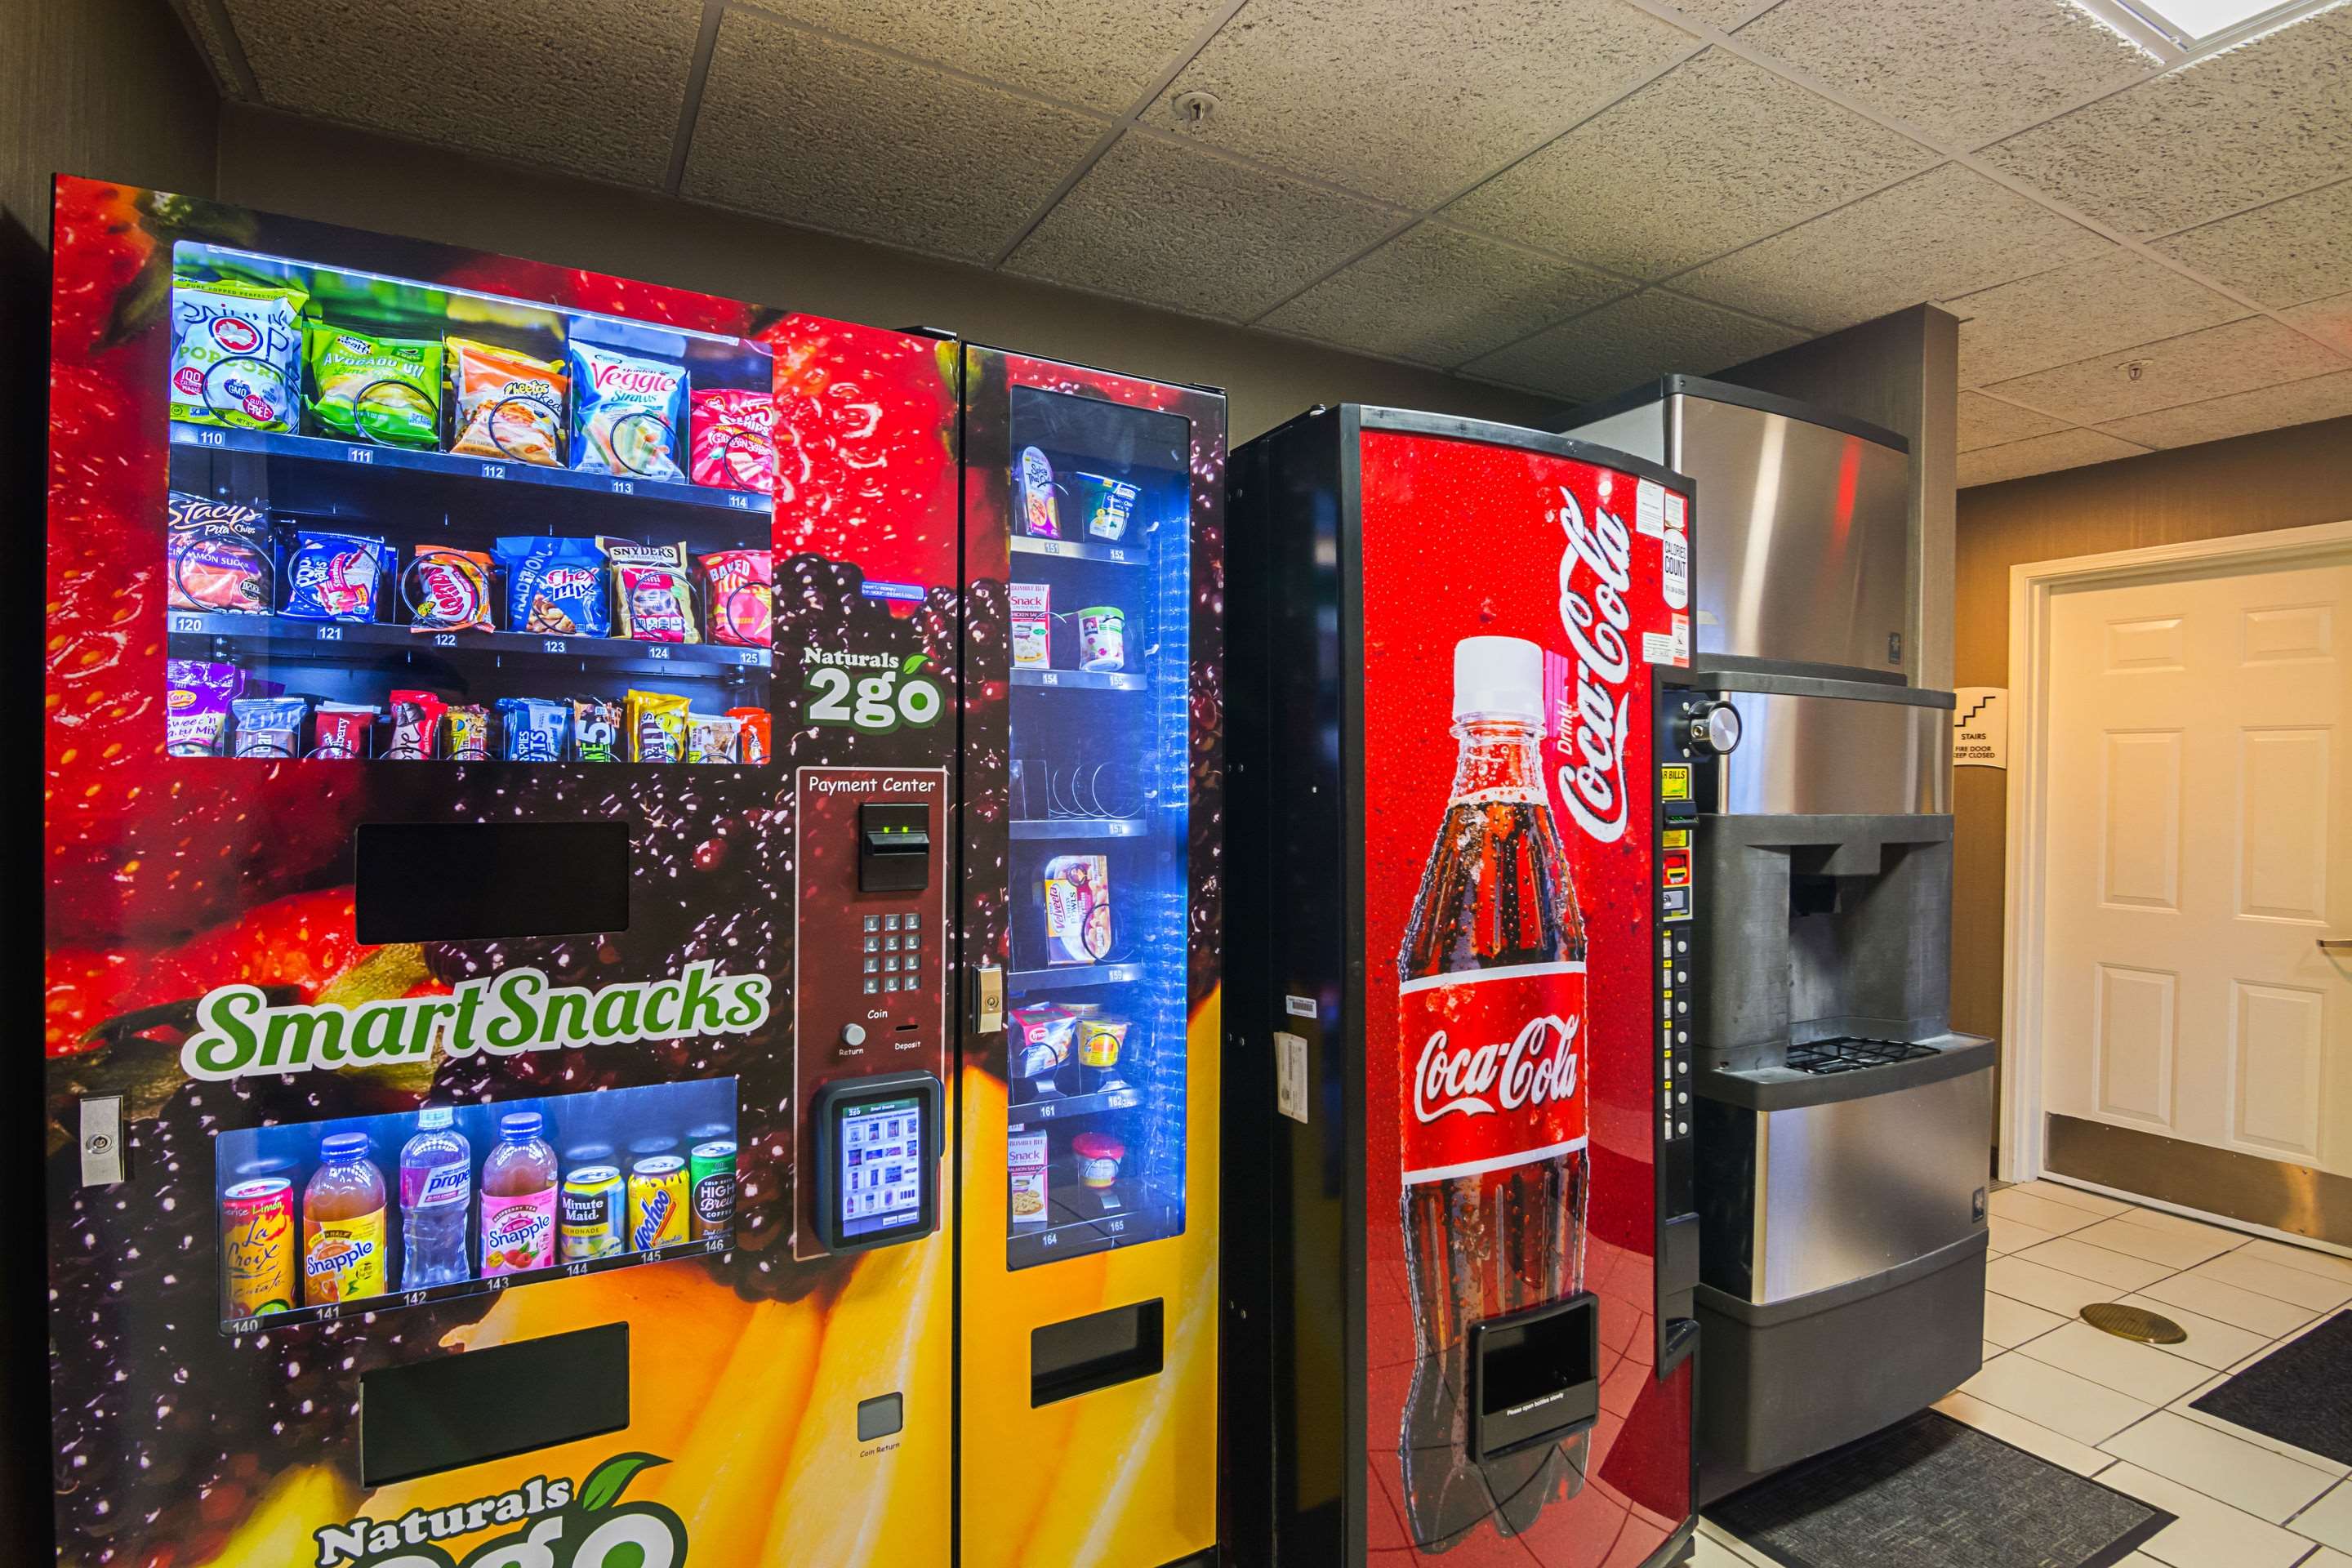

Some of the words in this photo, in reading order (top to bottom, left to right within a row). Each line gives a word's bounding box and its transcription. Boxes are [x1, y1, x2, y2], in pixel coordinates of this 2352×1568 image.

[323, 352, 398, 367] AVOCADO
[181, 368, 201, 381] 100
[590, 362, 676, 393] Veggie
[229, 385, 247, 398] GMO
[247, 403, 270, 419] FREE
[201, 432, 223, 445] 110
[351, 450, 370, 461] 111
[483, 466, 504, 478] 112
[614, 482, 632, 493] 113
[730, 496, 747, 507] 114
[204, 523, 229, 536] Pita
[612, 547, 675, 558] SNYDER'S
[1045, 542, 1059, 553] 151
[1665, 540, 1686, 560] CALORIES
[1110, 550, 1125, 559] 152
[709, 559, 751, 582] BAKED
[1665, 555, 1686, 579] COUNT
[546, 568, 600, 587] Chex
[1011, 596, 1042, 606] Snack
[177, 619, 202, 632] 120
[319, 627, 341, 639] 121
[434, 635, 456, 646] 122
[546, 641, 565, 653] 123
[649, 648, 668, 658] 124
[741, 653, 758, 663] 125
[804, 647, 900, 669] Naturals
[1558, 485, 1632, 844] Coca-Cola
[1043, 675, 1058, 684] 154
[809, 667, 940, 728] 2go
[195, 725, 216, 735] Mix
[1557, 697, 1574, 757] Drink!
[1668, 770, 1686, 780] BILLS
[808, 776, 878, 795] Payment
[882, 777, 936, 792] Center
[1050, 886, 1067, 929] Velveeta
[195, 965, 764, 1072] SmartSnacks
[867, 1009, 889, 1019] Coin
[894, 1040, 922, 1050] Deposit
[839, 1047, 864, 1057] Return
[1414, 1013, 1579, 1123] Coca-Cola
[1040, 1106, 1055, 1117] 161
[1009, 1151, 1040, 1161] Snack
[428, 1169, 470, 1193] prope
[701, 1183, 735, 1198] HIGH
[562, 1197, 604, 1210] Minute
[243, 1216, 268, 1247] La
[489, 1215, 550, 1248] Snapple
[1111, 1221, 1125, 1232] 165
[706, 1239, 724, 1252] 146
[1043, 1234, 1058, 1245] 164
[227, 1241, 279, 1270] Croix
[307, 1241, 373, 1276] Snapple
[641, 1250, 661, 1263] 145
[567, 1263, 588, 1276] 144
[487, 1276, 510, 1291] 143
[403, 1291, 427, 1306] 142
[317, 1306, 340, 1320] 141
[233, 1319, 258, 1334] 140
[1507, 1406, 1522, 1417] Please
[1522, 1402, 1535, 1412] open
[859, 1449, 875, 1458] Coin
[876, 1442, 901, 1454] Return
[318, 1477, 572, 1568] Naturals
